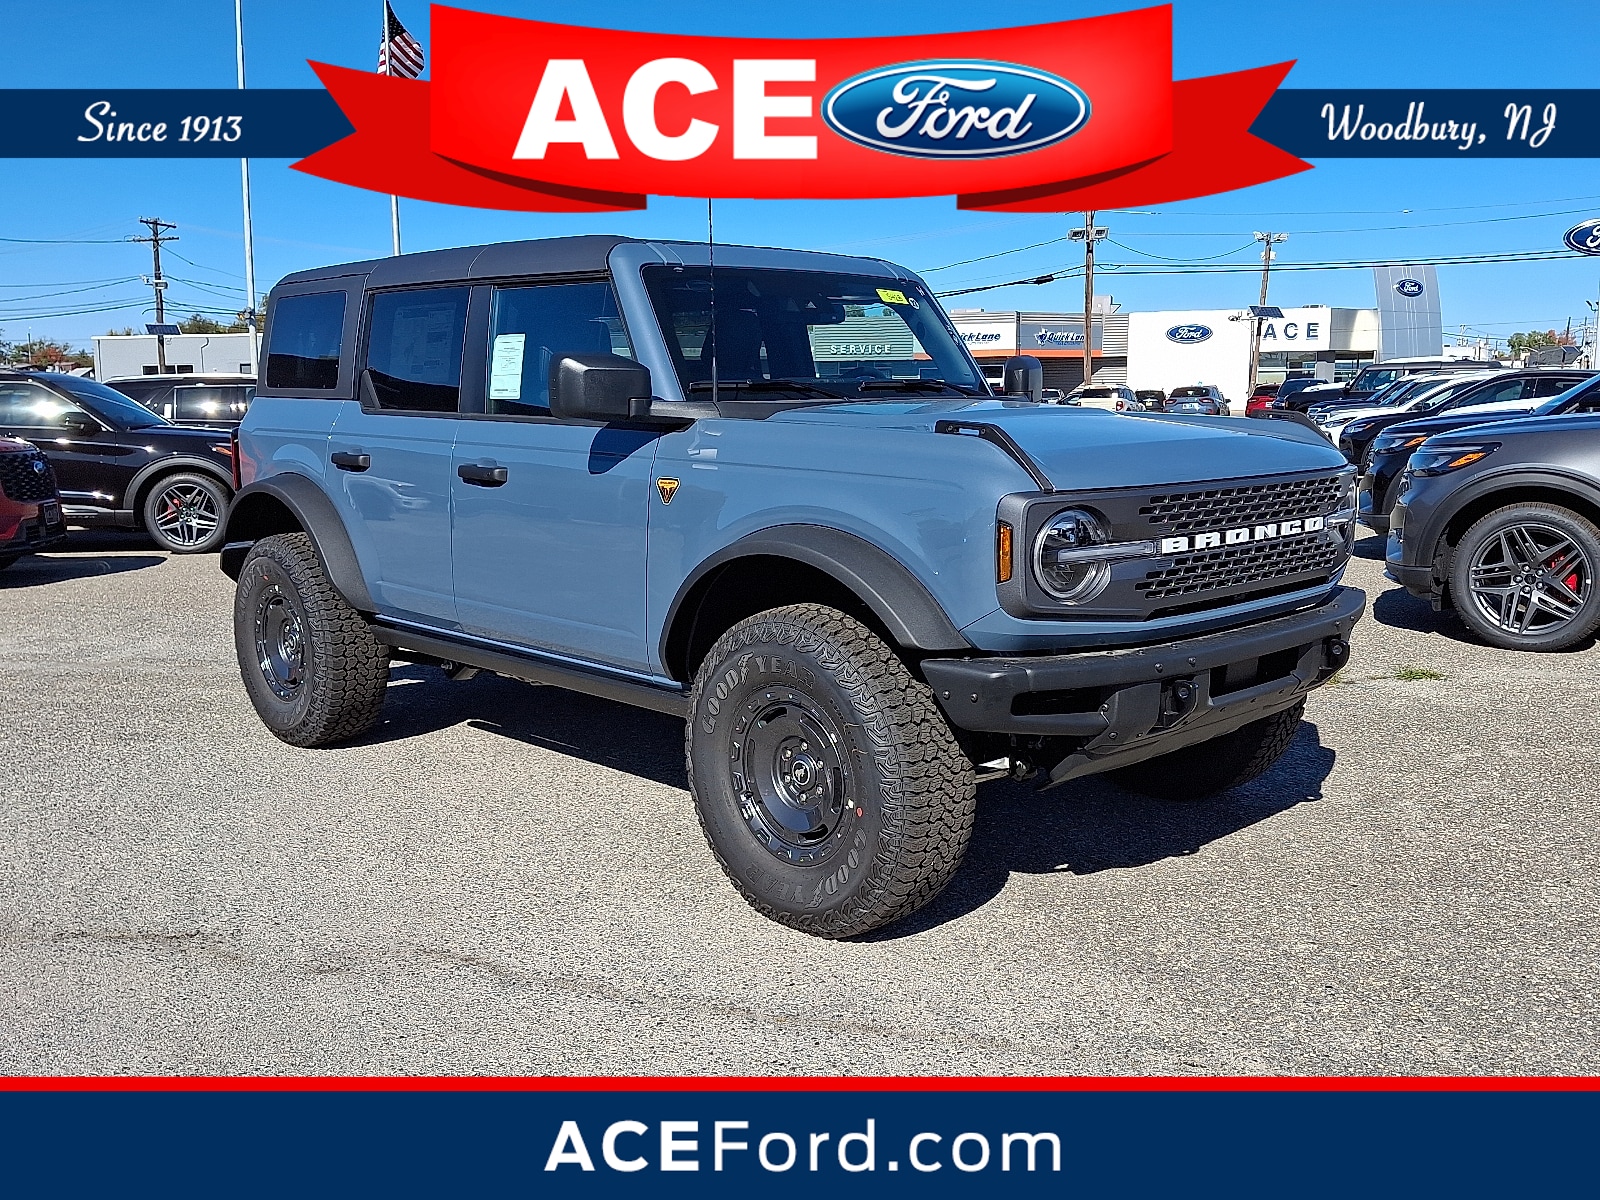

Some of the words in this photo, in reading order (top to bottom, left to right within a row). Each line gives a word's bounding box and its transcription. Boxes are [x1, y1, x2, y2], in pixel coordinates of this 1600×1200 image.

[1070, 332, 1085, 342] Lan
[1175, 326, 1203, 339] Ford
[1262, 322, 1320, 340] ACE
[830, 344, 892, 355] SERVICE
[1161, 516, 1325, 555] BRONCO
